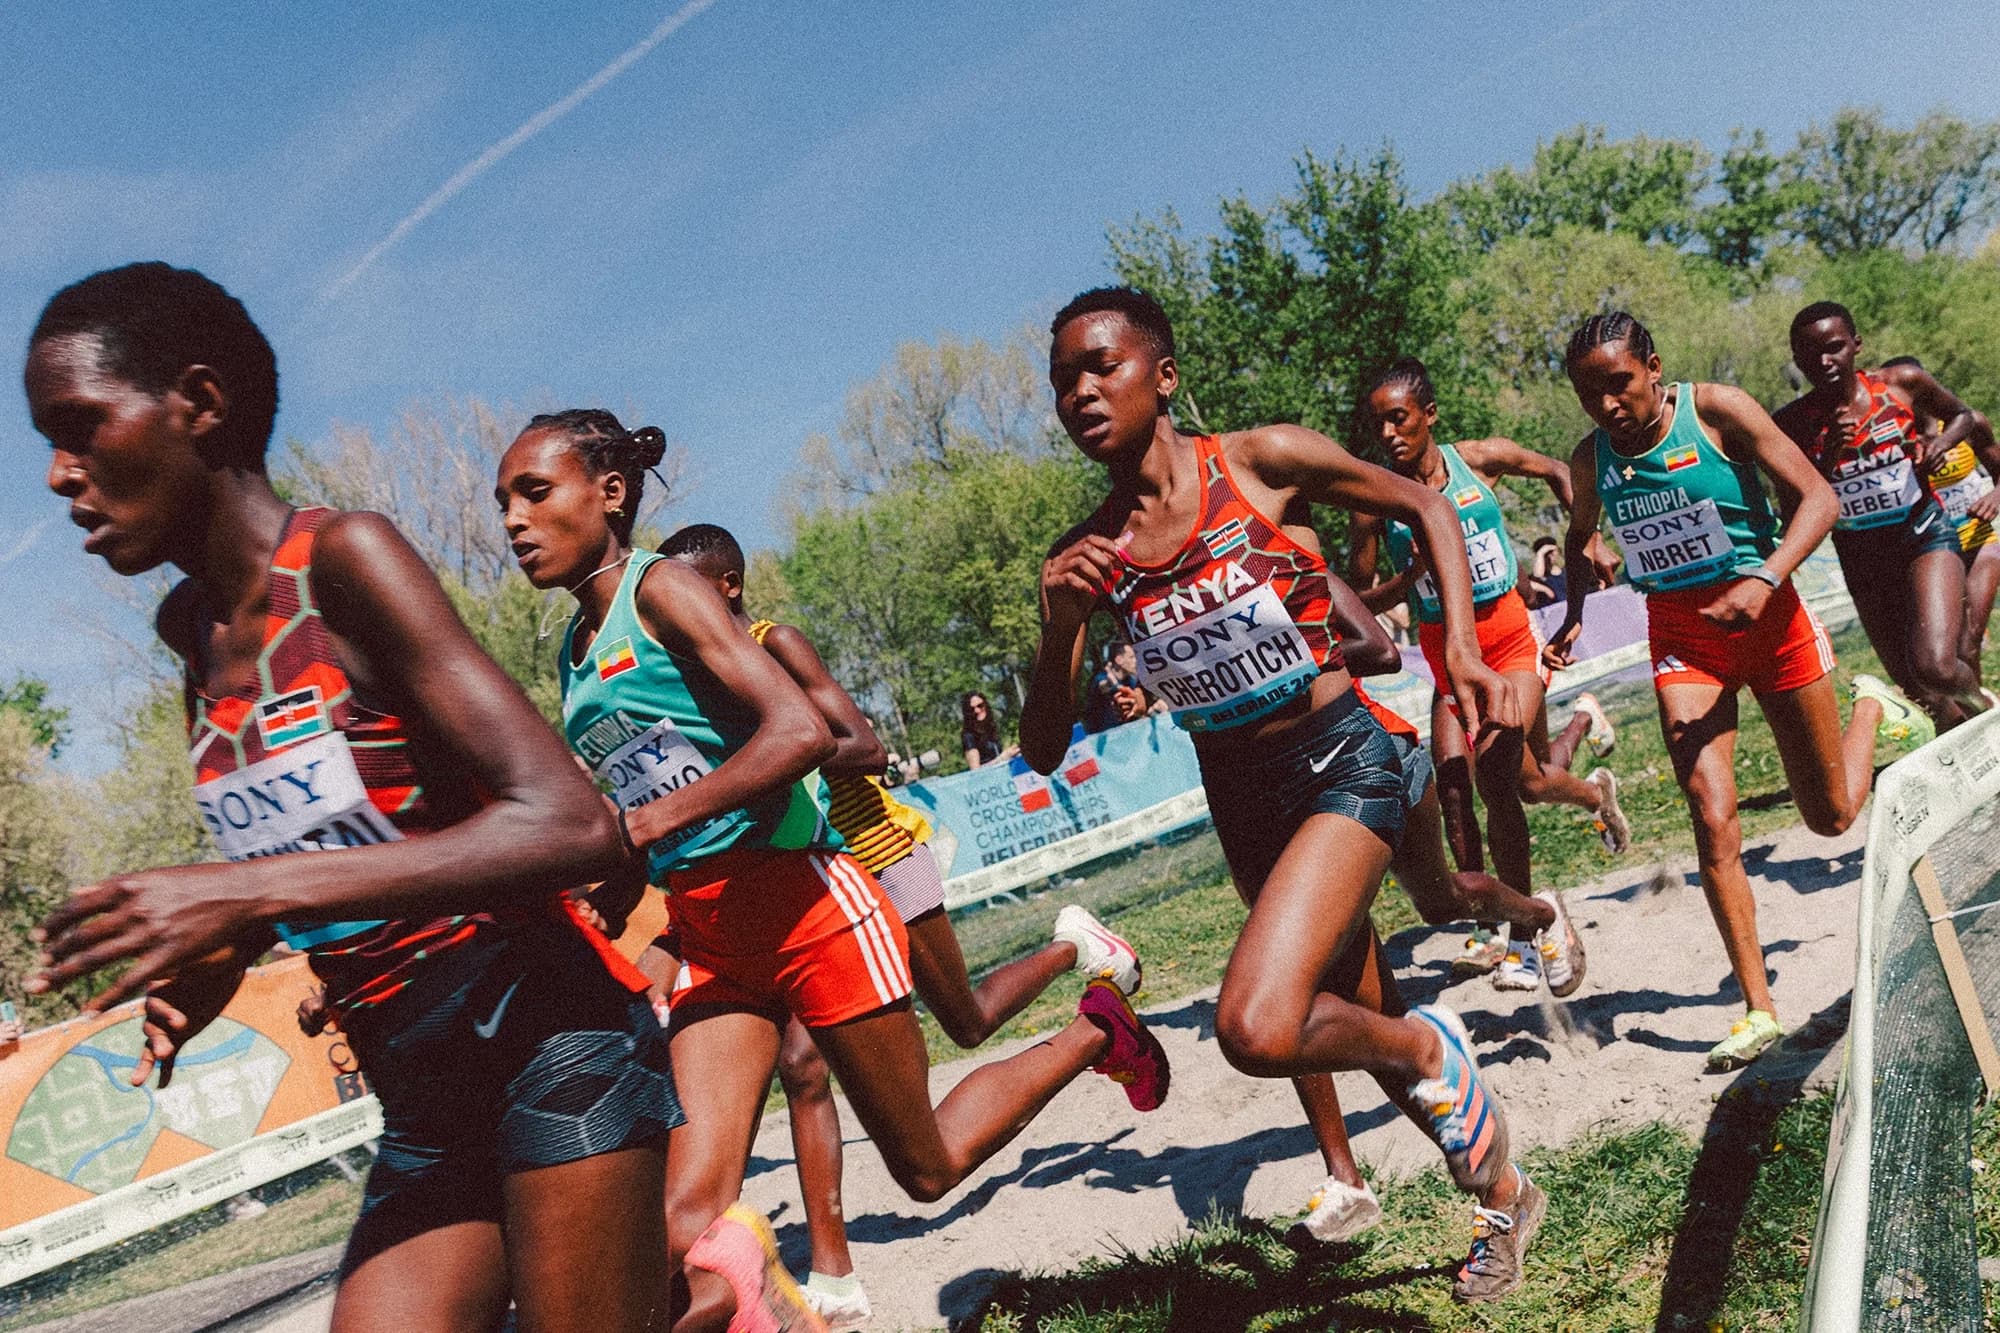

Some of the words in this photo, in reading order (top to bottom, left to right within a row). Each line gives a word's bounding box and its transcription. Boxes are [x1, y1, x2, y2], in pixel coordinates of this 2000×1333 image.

[1616, 487, 1692, 520] ETHIOPIA
[1841, 489, 1901, 516] JEBET
[1622, 508, 1704, 545] SONY
[1638, 533, 1712, 573] NBRET
[1125, 561, 1257, 643] KENYA
[1142, 601, 1263, 675] SONY
[1158, 631, 1303, 707] CHEROTICH
[1210, 684, 1291, 724] BELGRADE
[607, 734, 669, 789] ONY
[964, 782, 1017, 807] WORLD
[970, 799, 1024, 828] CROSS
[976, 794, 1109, 849] CHAMPIONSHIPS
